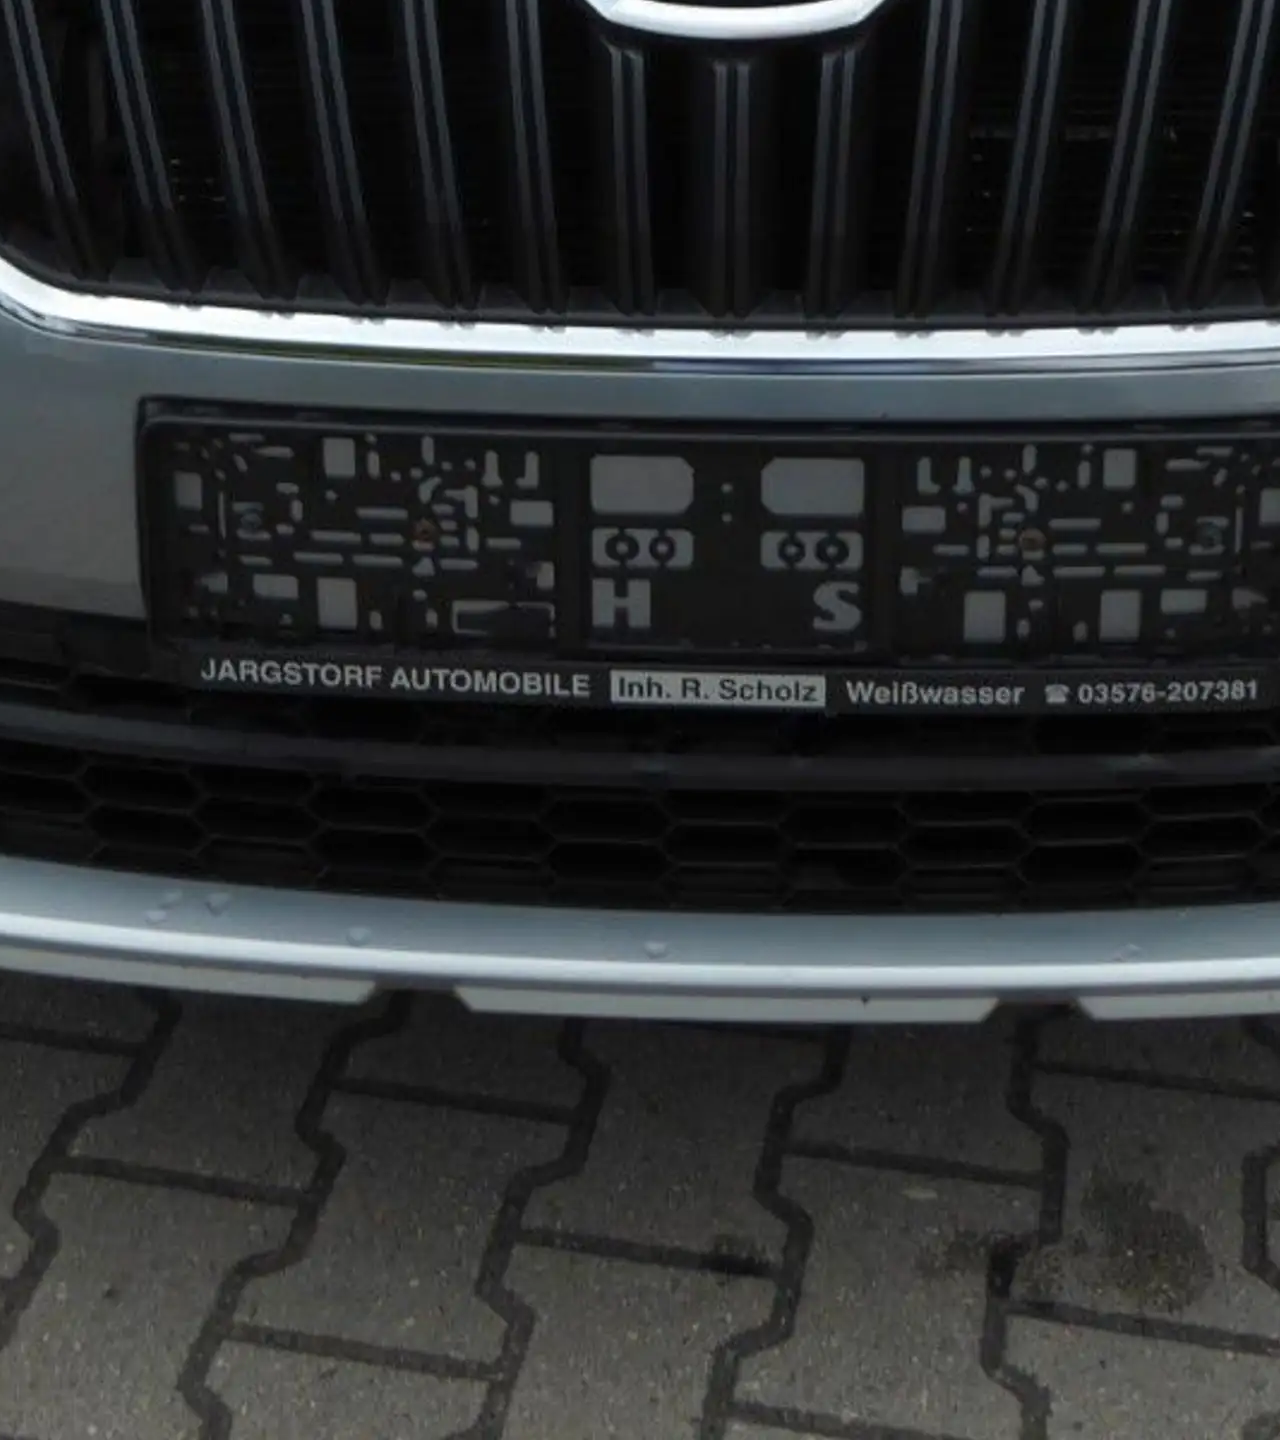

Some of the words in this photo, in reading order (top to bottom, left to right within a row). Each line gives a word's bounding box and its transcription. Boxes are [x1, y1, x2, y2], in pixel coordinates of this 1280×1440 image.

[200, 658, 382, 690] JARGSTORF
[390, 667, 591, 698] AUTOMOBILE
[617, 675, 672, 700] Inh.
[680, 679, 710, 702] R.
[717, 677, 817, 704] Scholz
[846, 680, 1026, 706] Weißwasser
[1077, 679, 1259, 704] 03576-207381
